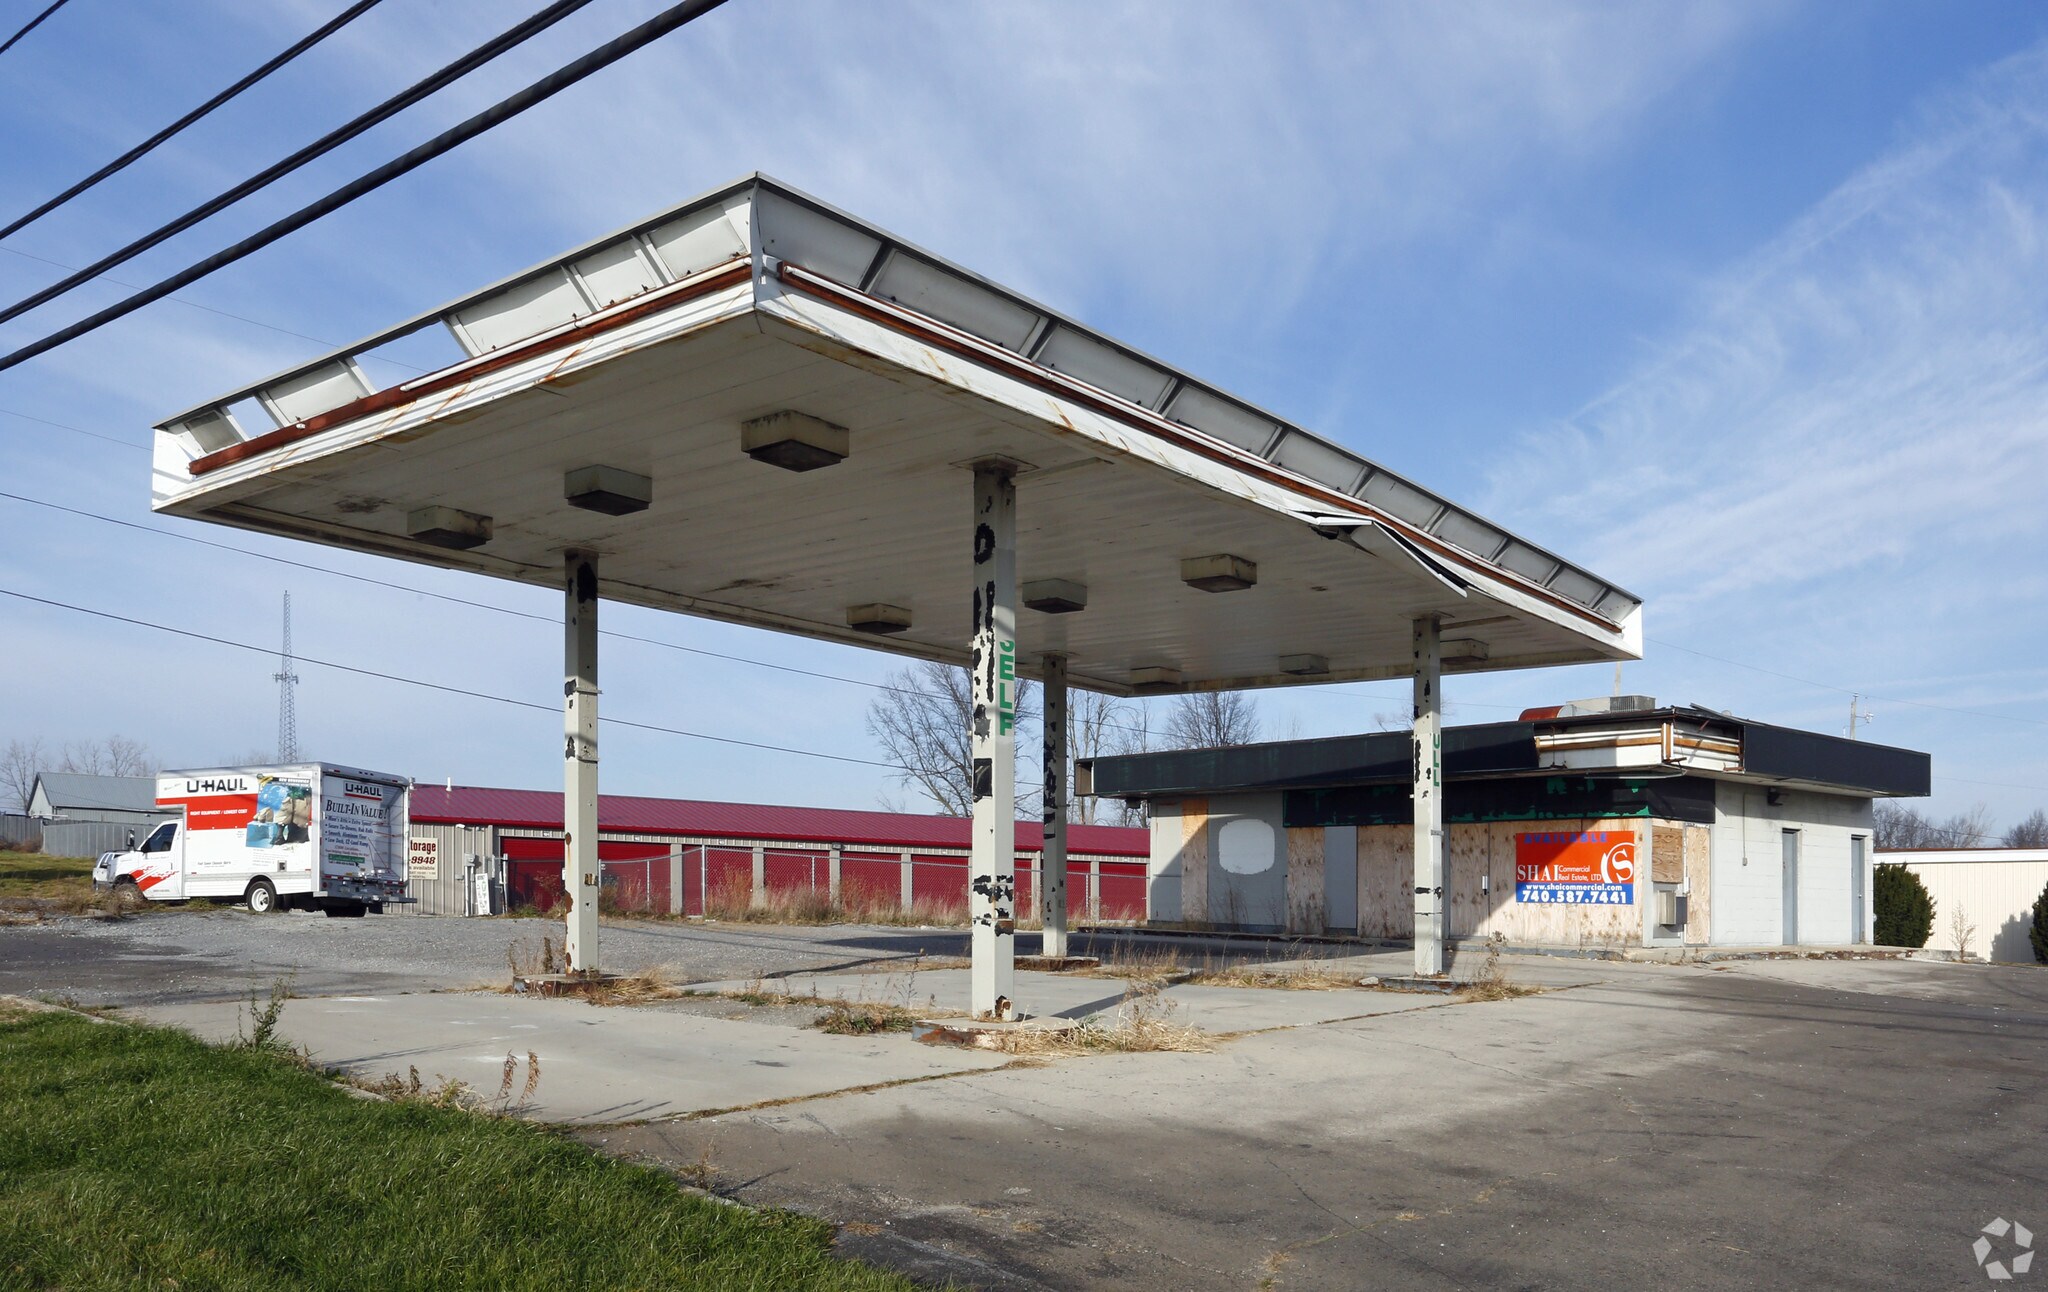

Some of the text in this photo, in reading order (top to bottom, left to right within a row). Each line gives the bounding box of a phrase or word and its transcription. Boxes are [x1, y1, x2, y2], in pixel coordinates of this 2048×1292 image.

[187, 778, 248, 793] U-HAUL
[345, 783, 382, 797] U-HAUL
[1524, 832, 1608, 844] AVAILABLE
[410, 840, 436, 854] torage
[410, 856, 436, 864] -9948
[1518, 864, 1559, 881] SHAI
[1522, 890, 1626, 903] 740.587.7441
